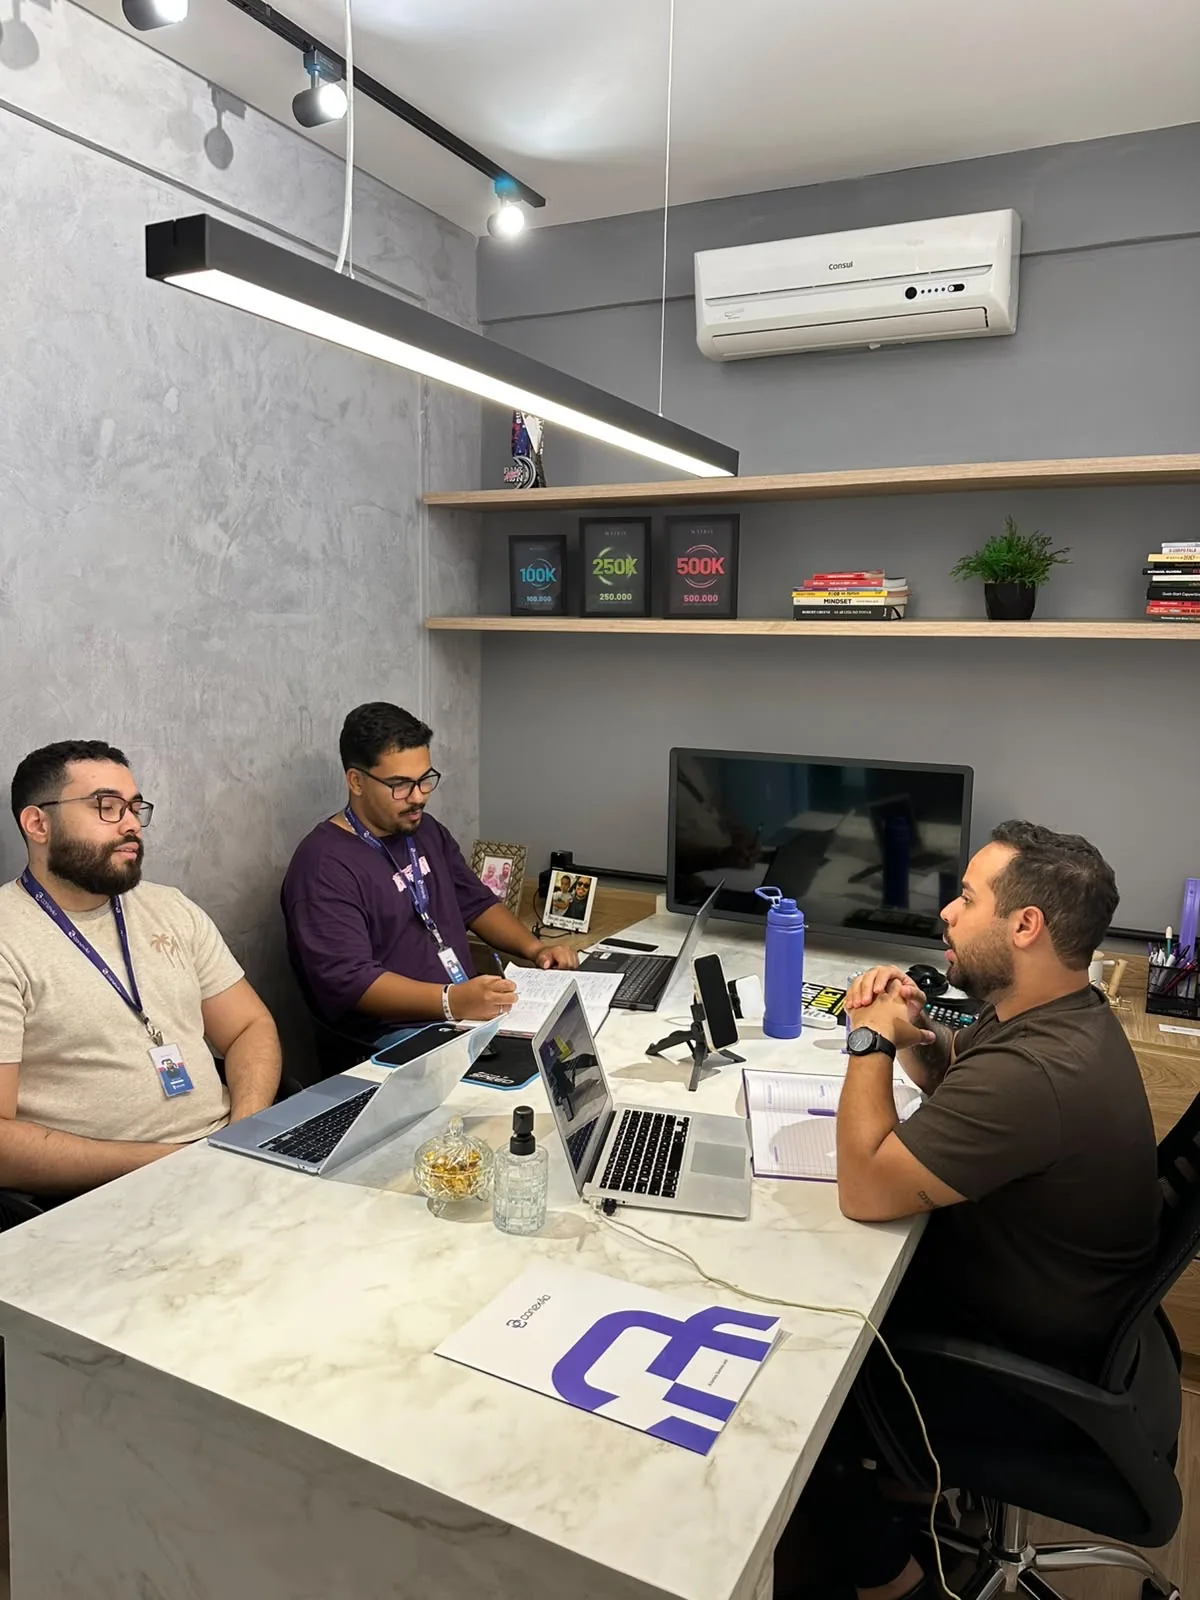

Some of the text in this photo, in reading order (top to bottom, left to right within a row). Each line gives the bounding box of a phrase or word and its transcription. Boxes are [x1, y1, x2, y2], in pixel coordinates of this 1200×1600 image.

[592, 558, 638, 575] 250K
[677, 557, 725, 575] 500K
[520, 567, 557, 583] 100K
[599, 593, 632, 601] 250.000
[683, 594, 718, 602] 500.000
